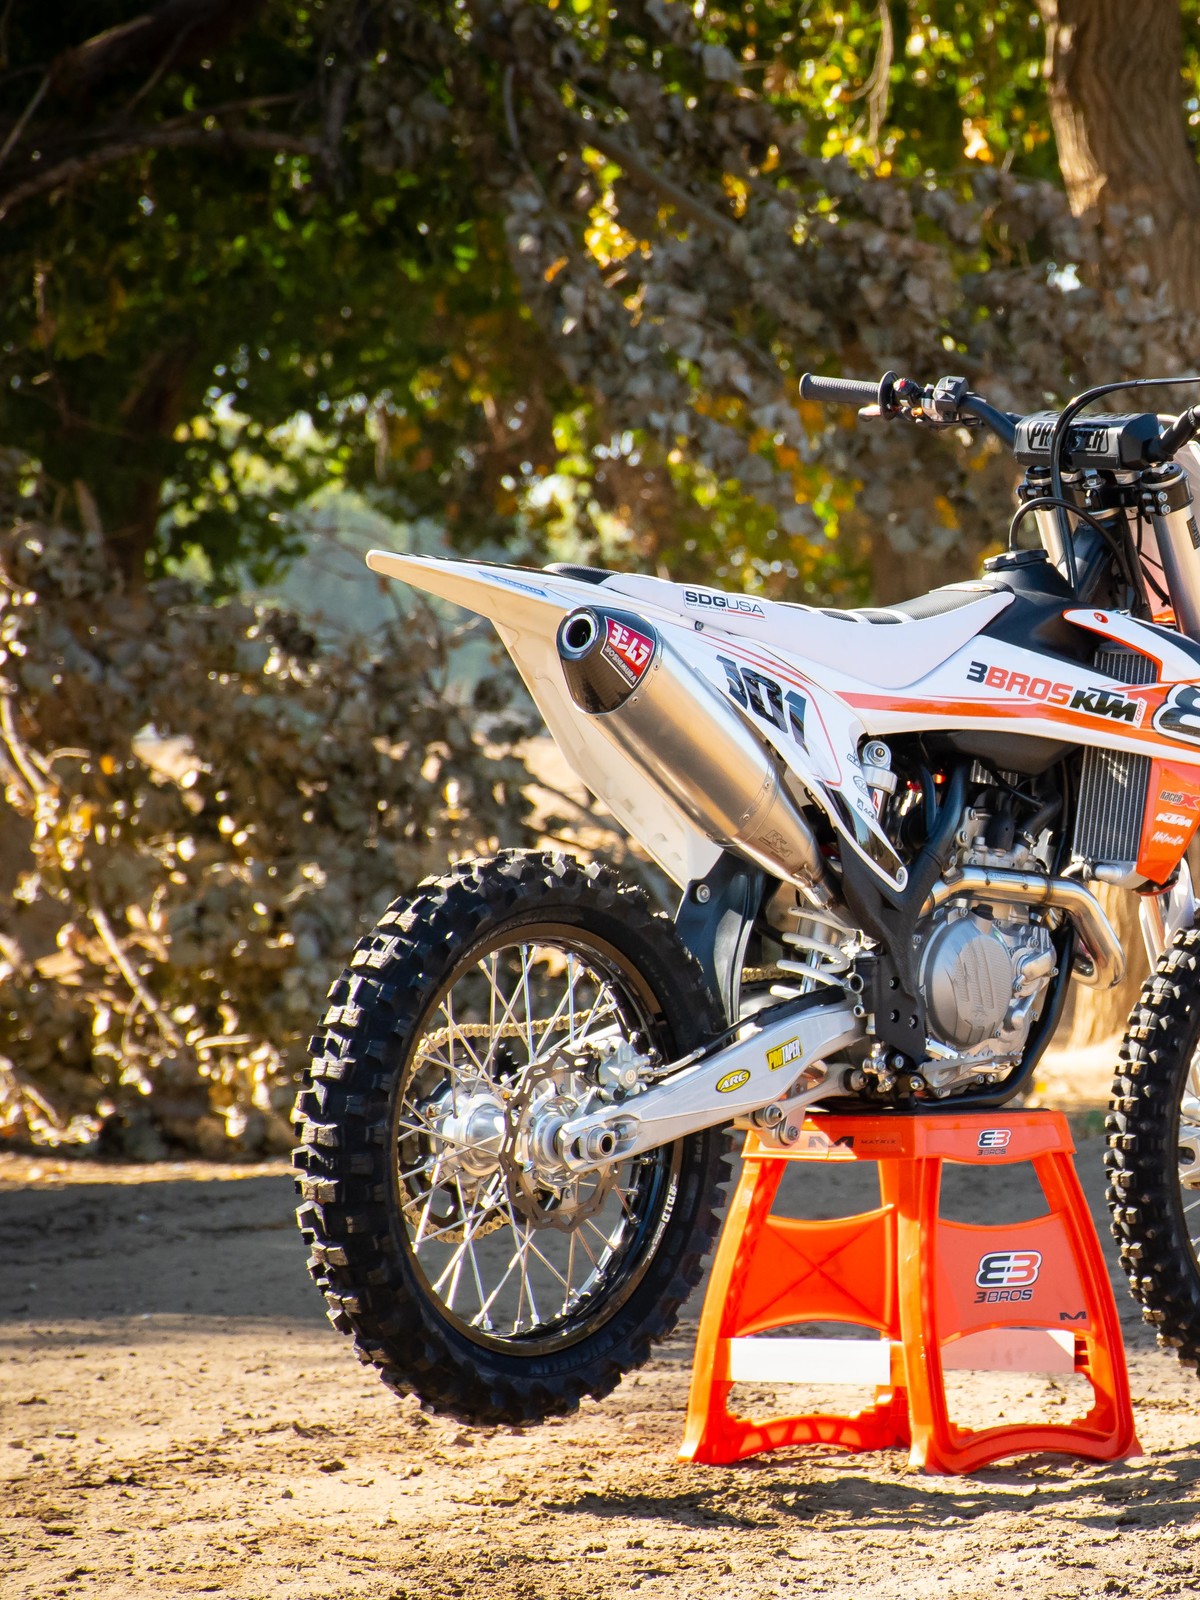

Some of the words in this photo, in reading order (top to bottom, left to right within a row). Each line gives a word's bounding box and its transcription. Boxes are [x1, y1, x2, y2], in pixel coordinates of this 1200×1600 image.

[608, 622, 650, 667] ヨシムラ
[605, 645, 638, 684] YOSHIMURA
[1155, 813, 1193, 828] KTM
[719, 1070, 747, 1091] ARC
